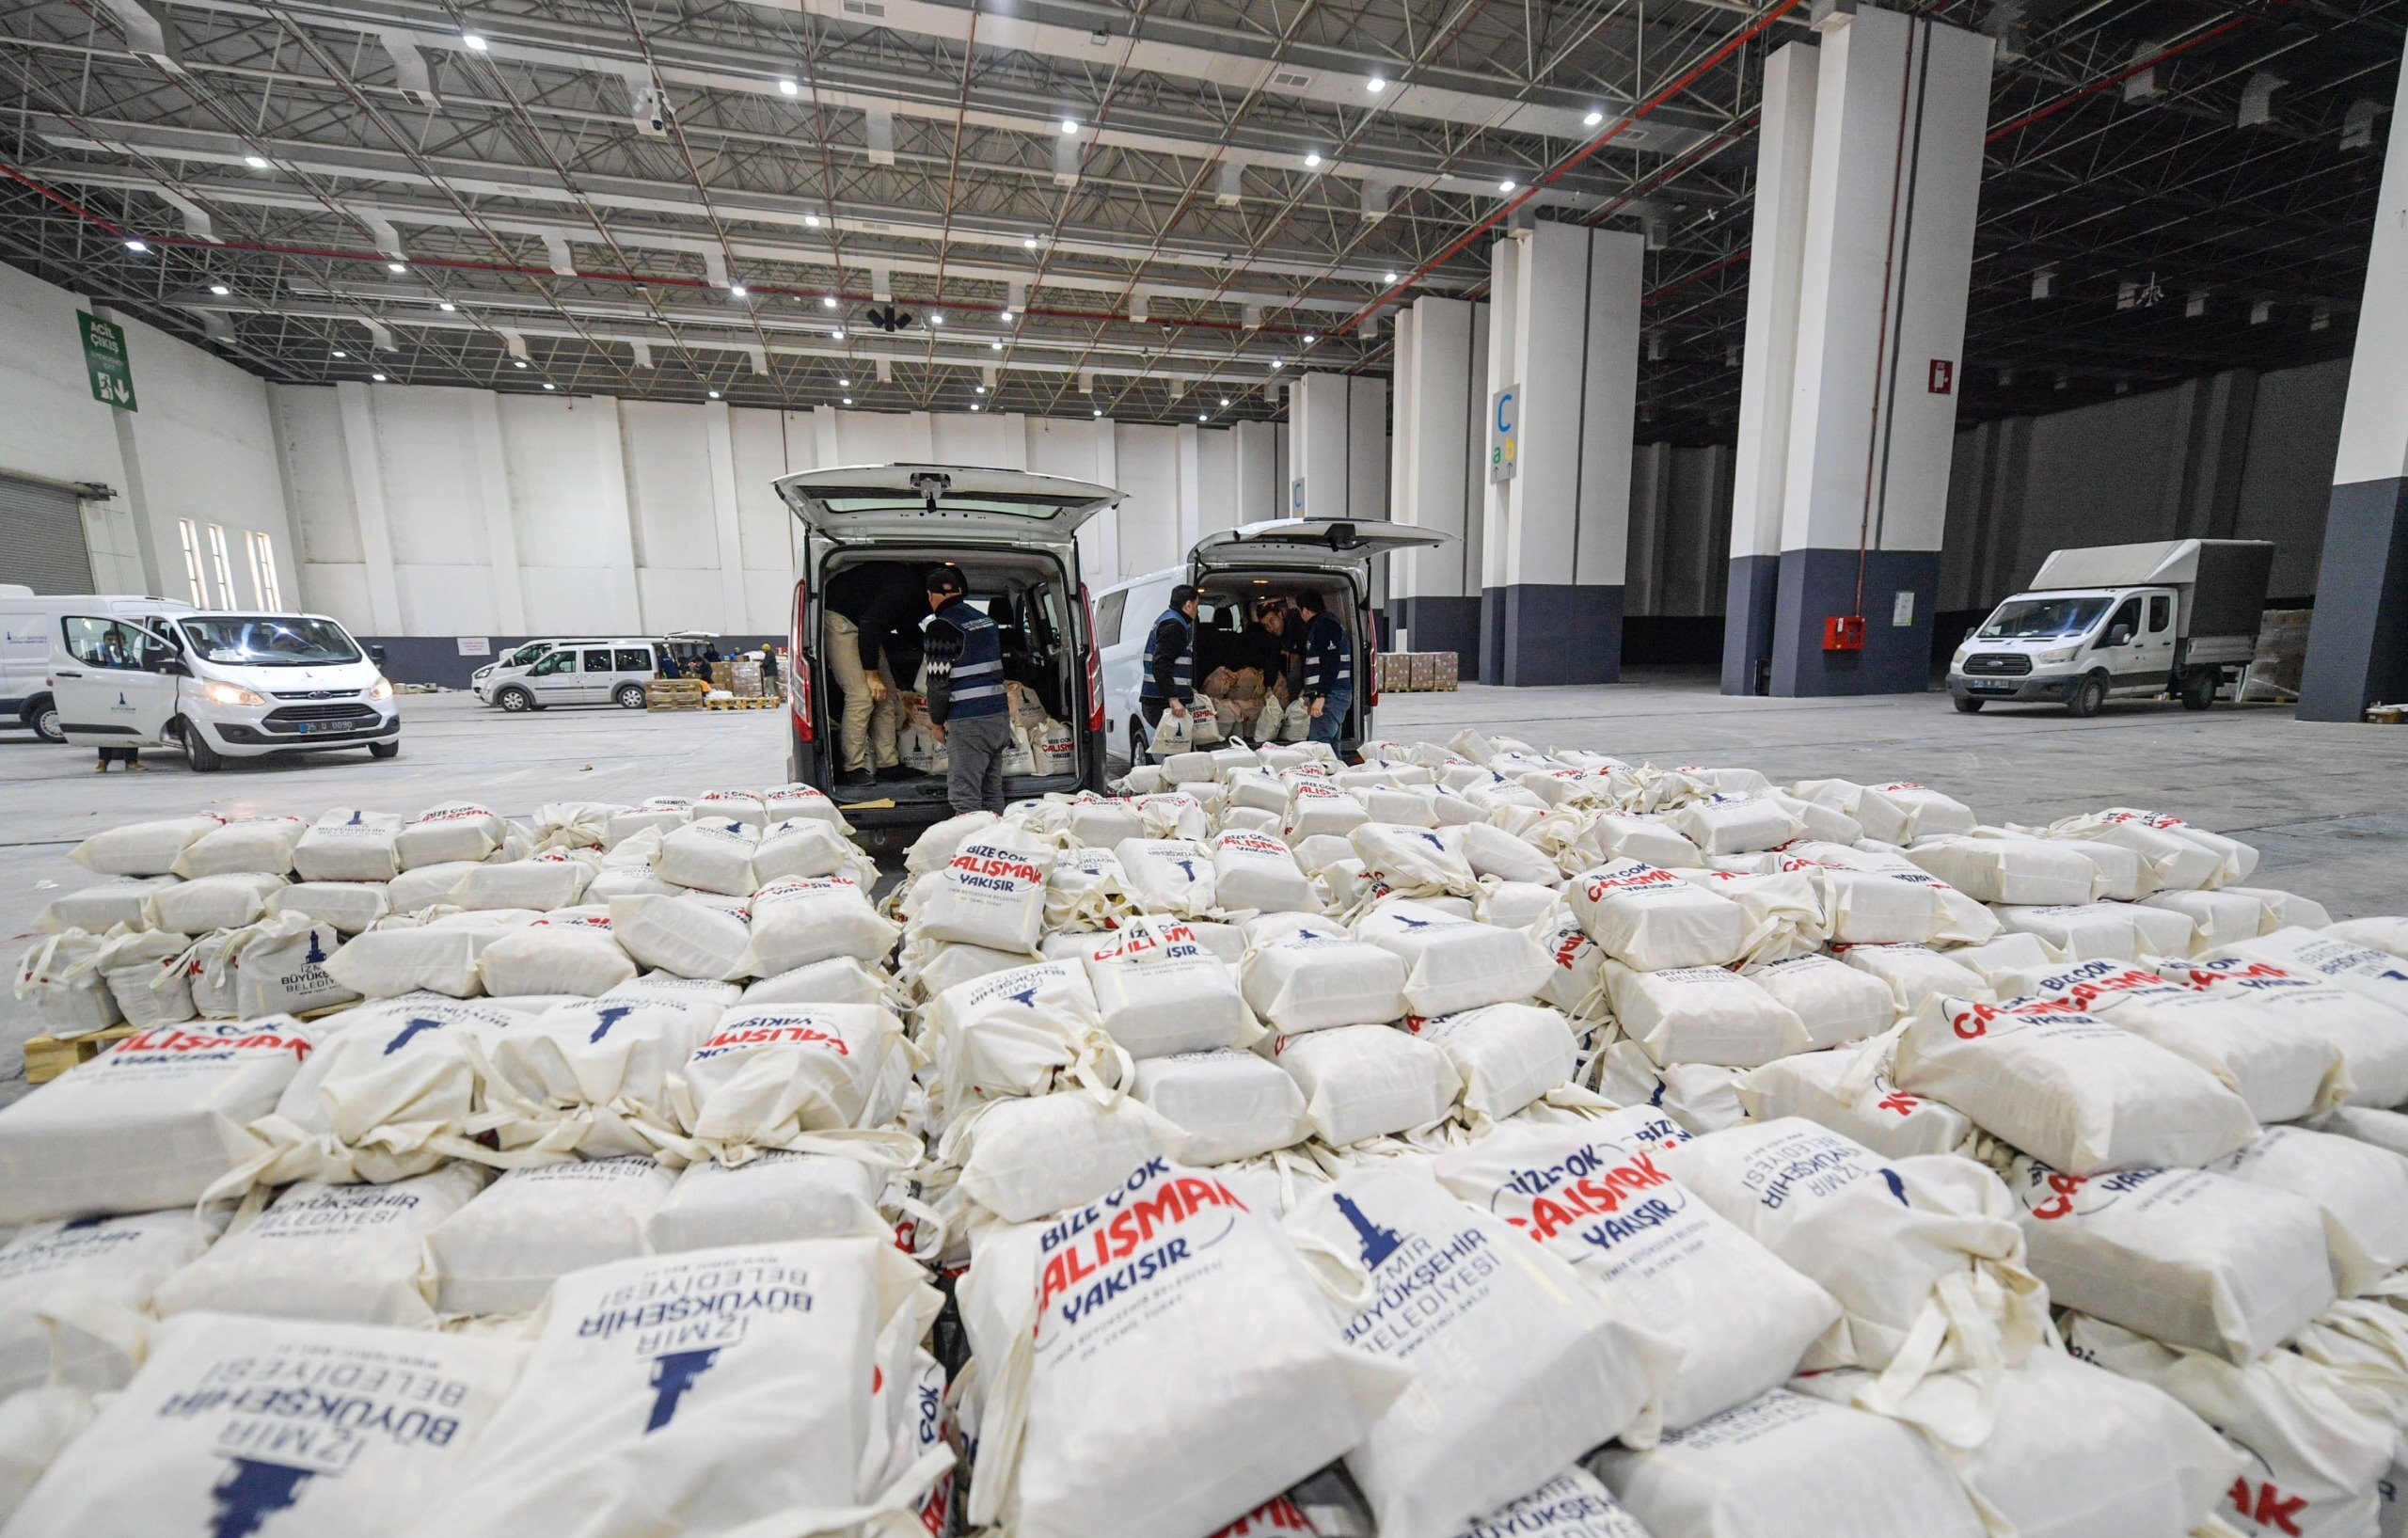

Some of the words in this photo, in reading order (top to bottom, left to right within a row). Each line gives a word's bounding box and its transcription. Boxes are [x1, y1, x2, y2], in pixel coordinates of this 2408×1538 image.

[90, 322, 115, 340] ACİL
[90, 333, 119, 355] ÇIKIŞ
[1497, 394, 1513, 433] C
[1493, 447, 1501, 464] a
[1505, 436, 1515, 461] b
[1294, 484, 1302, 508] C
[967, 844, 996, 858] BİZE
[997, 850, 1028, 863] ÇOK
[1619, 863, 1652, 878] ÇOK
[959, 873, 1015, 892] YAKIŞIR
[281, 971, 329, 985] BÜYÜKŞ
[286, 978, 335, 992] BELEDİY
[301, 964, 322, 973] İZM
[727, 1017, 813, 1031] YAKIŞIR
[1040, 1204, 1101, 1253] BİZE
[1105, 1155, 1170, 1207] ÇOK
[1581, 1197, 1677, 1250] YAKIŞIR
[1033, 1177, 1250, 1340] ALIŞMA
[1373, 1237, 1433, 1294] ZMİR
[598, 1266, 810, 1309] BELEDİYESİ
[1062, 1237, 1191, 1325] YAKIŞIR
[577, 1287, 815, 1340] BÜYÜKŞEHİR
[636, 1312, 752, 1356] İZMİR
[199, 1356, 468, 1408] BELEDİYESİ
[158, 1386, 460, 1448] BÜYÜKŞEHİR
[918, 1385, 939, 1445] ÇOK
[216, 1418, 368, 1467] İZMİR
